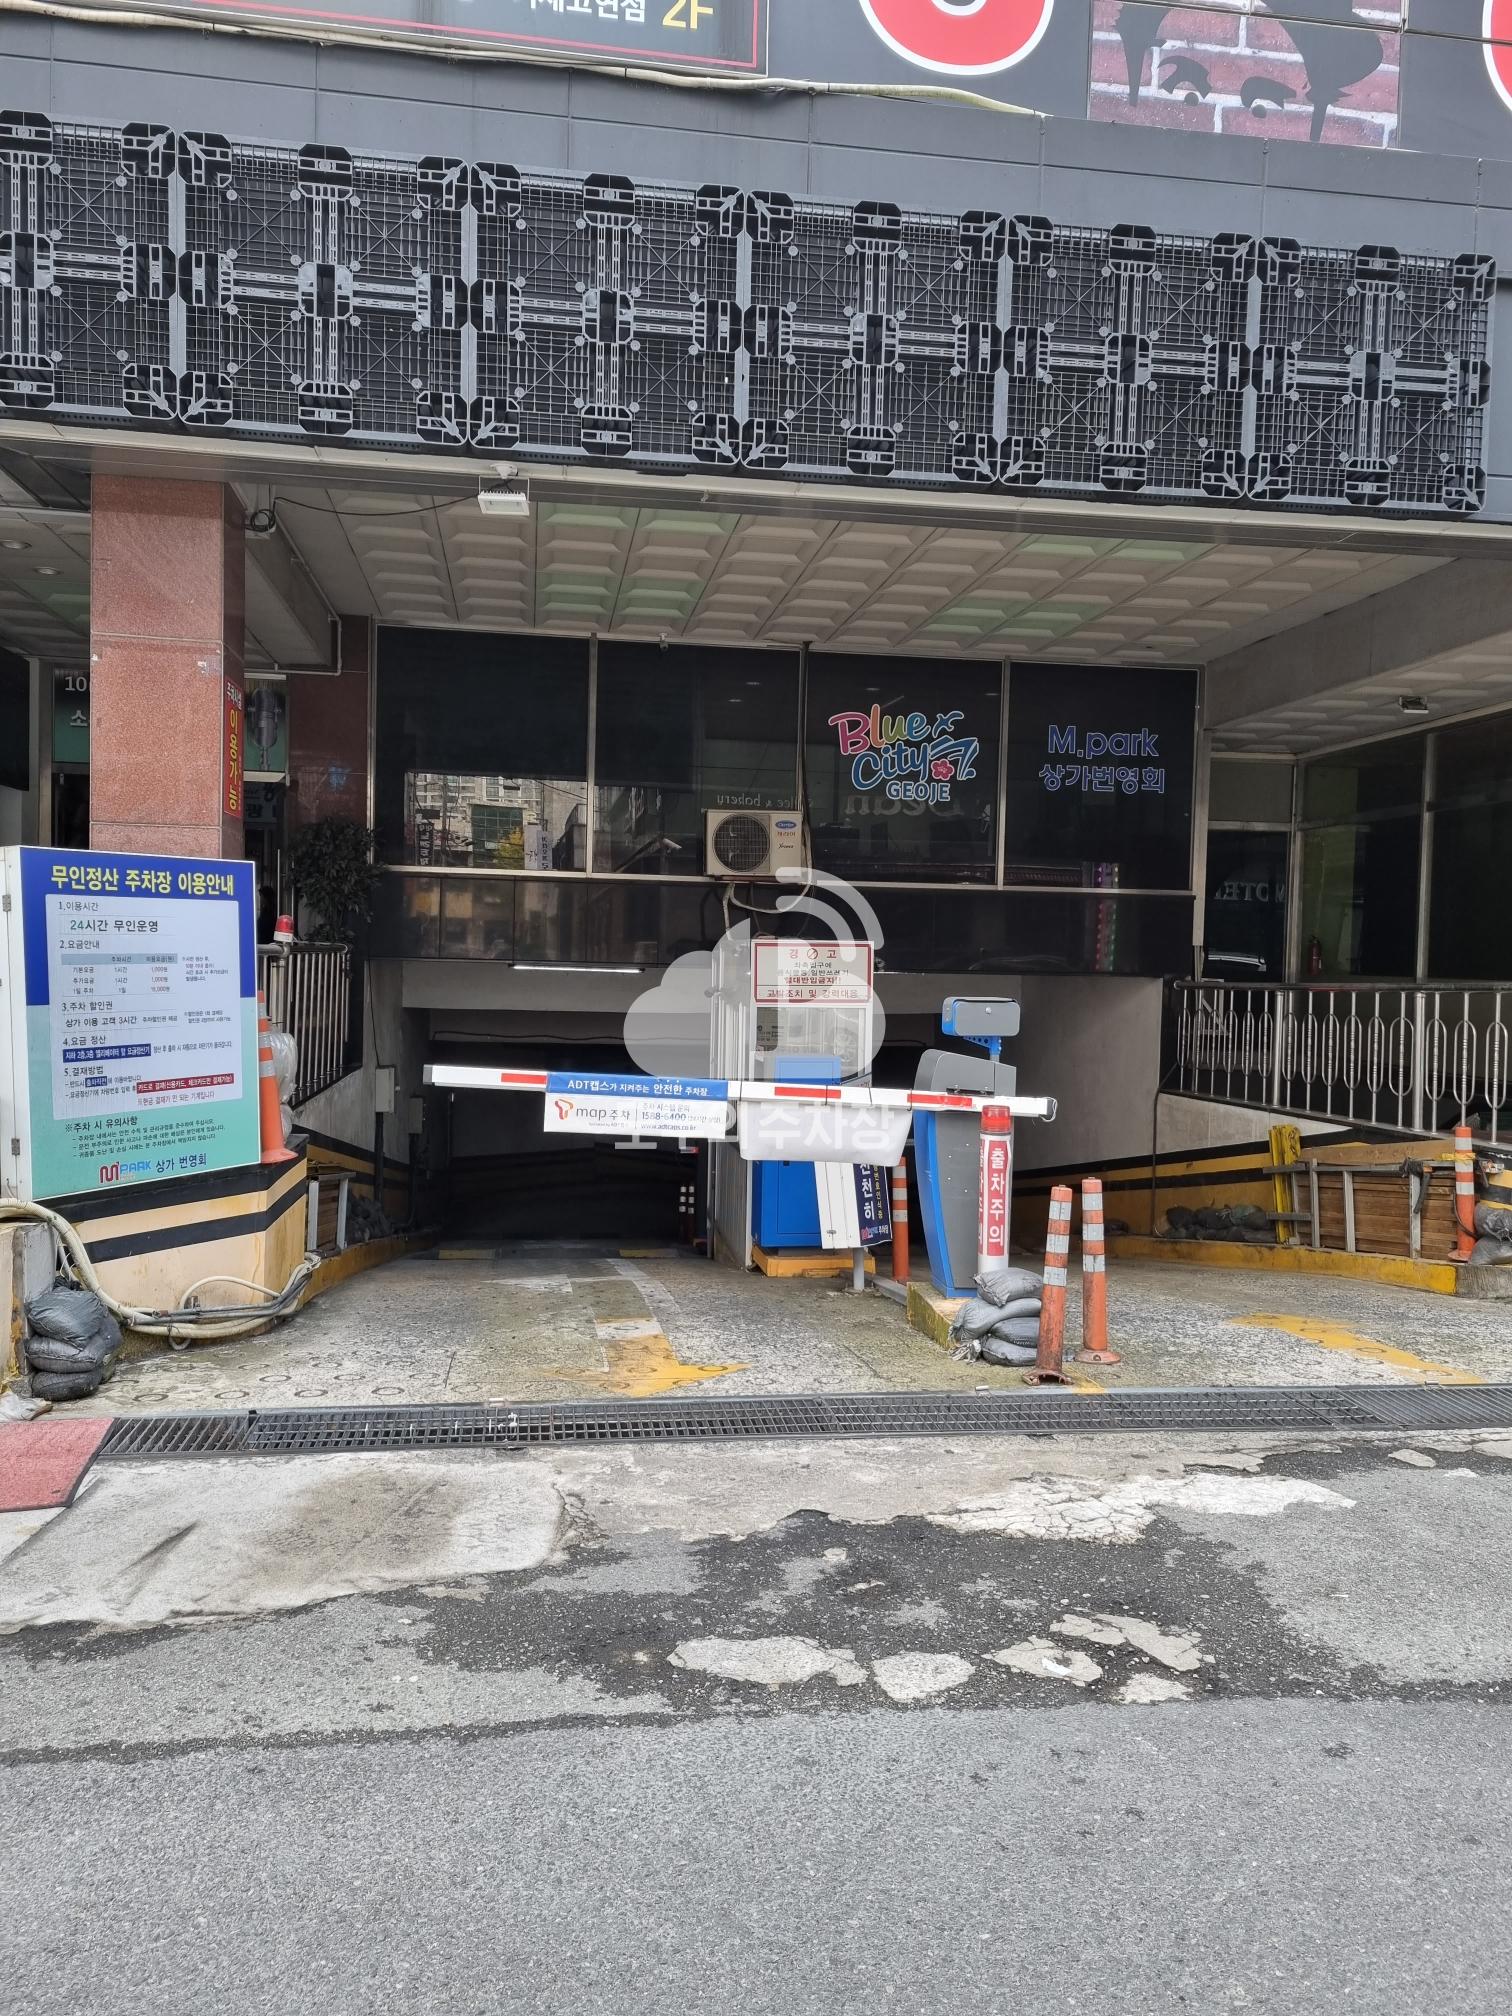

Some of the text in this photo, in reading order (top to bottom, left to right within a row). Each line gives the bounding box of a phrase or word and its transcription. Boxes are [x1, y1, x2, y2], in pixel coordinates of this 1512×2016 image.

[828, 703, 931, 755] Blue
[1048, 725, 1159, 759] M.park
[852, 742, 928, 790] City
[1039, 764, 1165, 794] 상가번영회
[886, 781, 951, 805] GEOJE
[51, 865, 234, 896] 무인정산 주차장 이용안내
[58, 901, 99, 912] 1.이용시간
[70, 919, 158, 933] 24시간 무인운영
[59, 940, 100, 949] 2.요금안내
[62, 1001, 113, 1012] 3.주차 할인권
[66, 1018, 81, 1028] 상가
[83, 1017, 98, 1026] 이용
[101, 1016, 116, 1025] 고객
[118, 1016, 137, 1025] 3시간
[63, 1035, 106, 1047] 4.요금 정산
[567, 1080, 708, 1096] ADT캡스가 지켜주는 안전한 주차장
[94, 1120, 102, 1130] 시
[105, 1116, 138, 1129] 유의사항
[641, 1112, 687, 1121] 1588-6400
[155, 1158, 175, 1173] 상가
[179, 1153, 207, 1169] 번영회
[988, 1147, 1005, 1247] 출차주의
